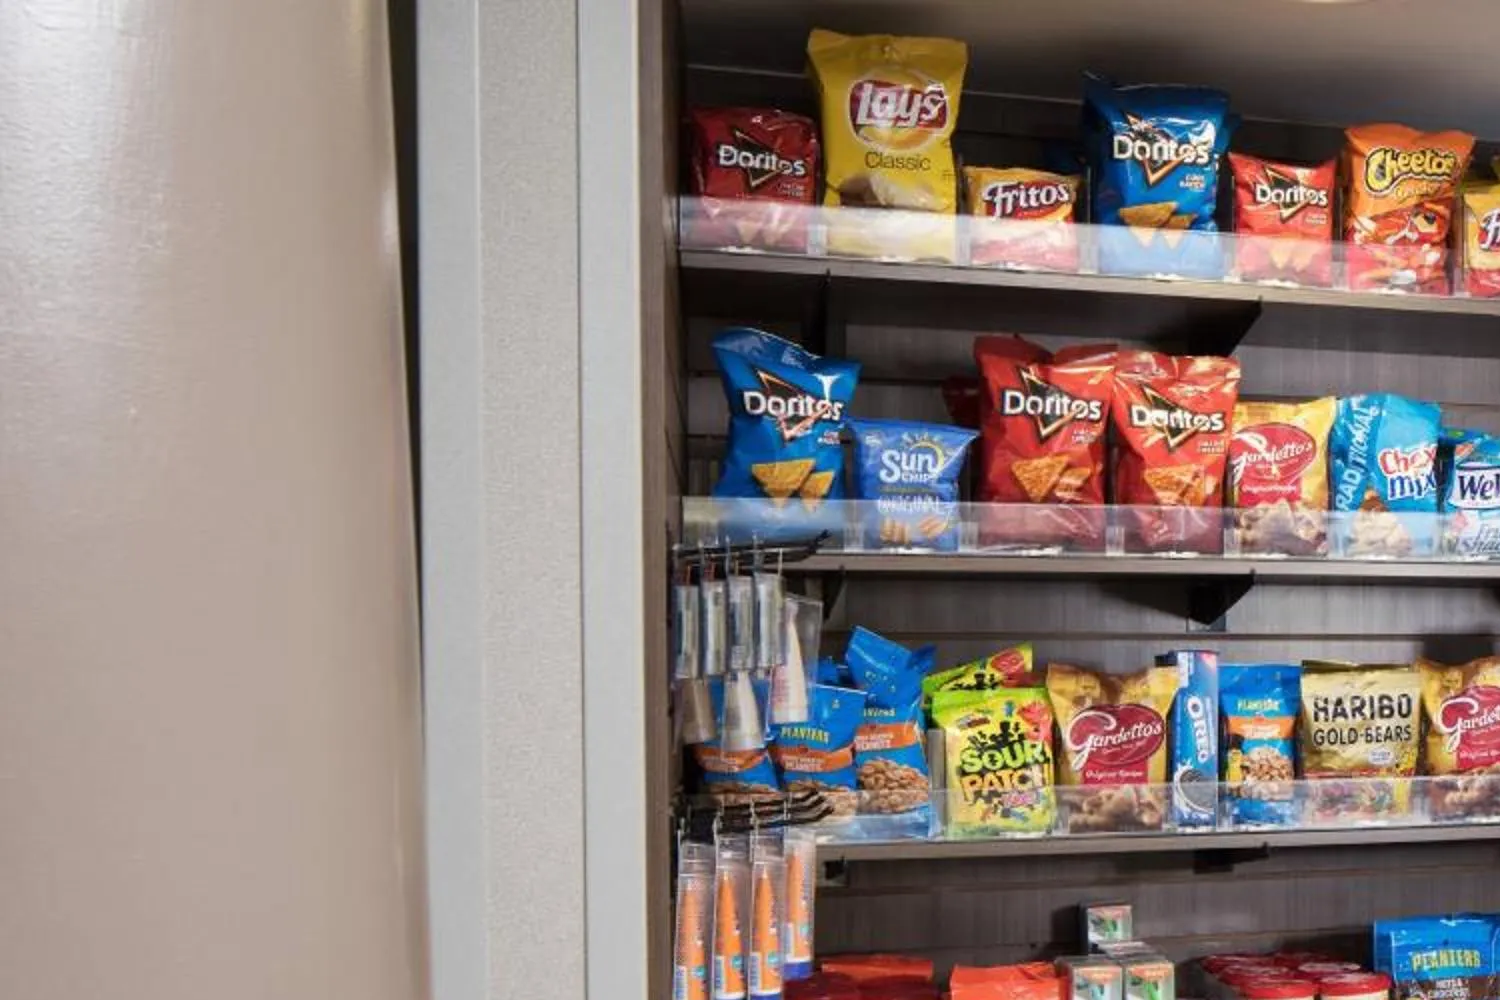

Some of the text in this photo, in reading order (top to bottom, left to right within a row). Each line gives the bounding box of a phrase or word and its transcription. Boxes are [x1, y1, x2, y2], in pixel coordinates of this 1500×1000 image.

[718, 145, 806, 176] Doritos
[864, 151, 932, 171] Classic
[1112, 135, 1210, 164] Doritos
[1366, 149, 1456, 193] Cheetos
[983, 181, 1070, 220] Fritos
[1255, 184, 1328, 206] Doritos
[743, 390, 843, 421] Doritos
[1004, 390, 1102, 421] Doritos
[1132, 405, 1225, 431] Doritos
[880, 449, 939, 483] Sun
[1379, 446, 1438, 475] Chex
[1313, 693, 1413, 722] HARIBO
[1067, 710, 1162, 772] Gardetto's
[1313, 725, 1412, 746] GOLD-BEARS
[960, 741, 1046, 773] SOUR
[1411, 950, 1482, 971] PLANTERS
